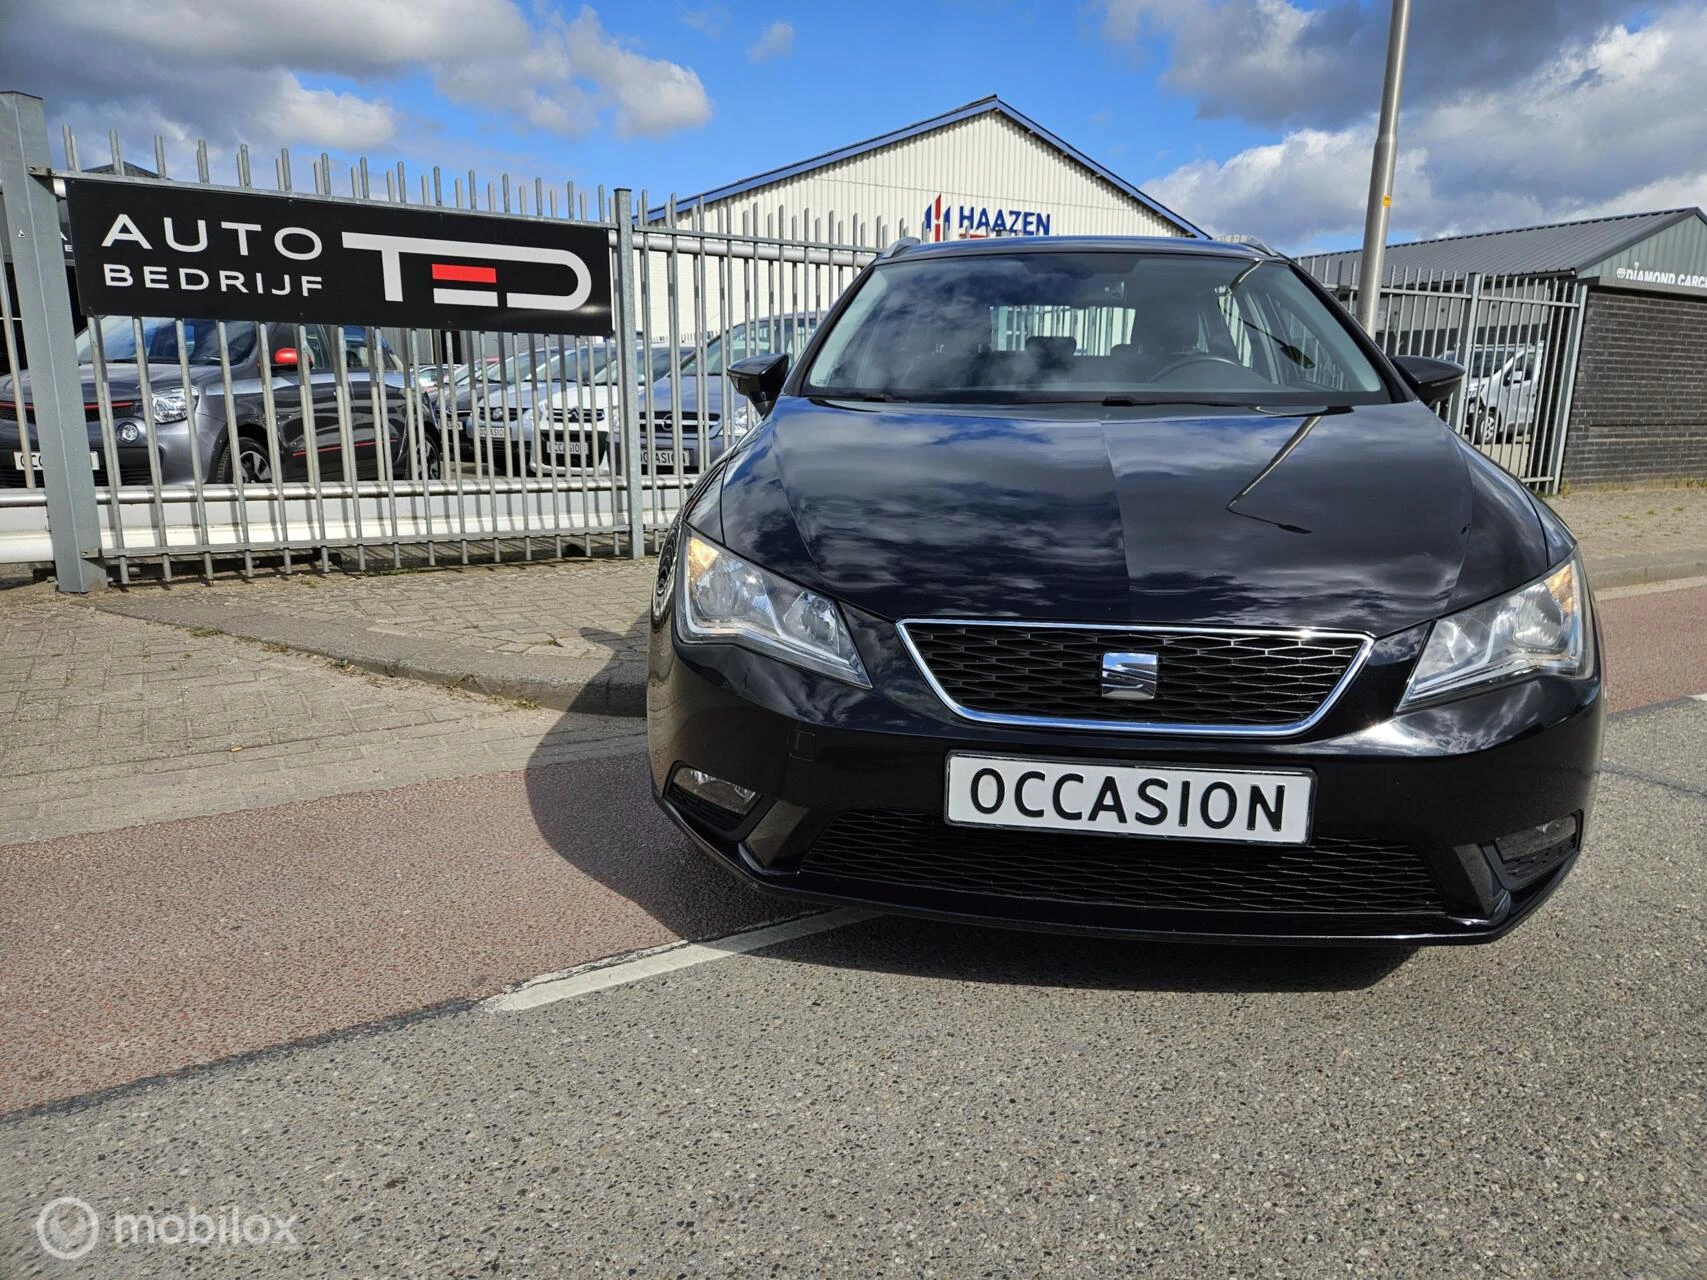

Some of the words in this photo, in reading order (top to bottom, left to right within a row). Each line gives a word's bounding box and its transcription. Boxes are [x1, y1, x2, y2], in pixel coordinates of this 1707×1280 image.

[101, 213, 323, 261] AUTO
[959, 205, 1051, 236] HAAZEN
[103, 263, 323, 297] BEDRIJF
[341, 231, 592, 311] TED
[1677, 273, 1707, 288] CARC
[640, 452, 686, 464] CASI
[970, 767, 1286, 832] OCCASION
